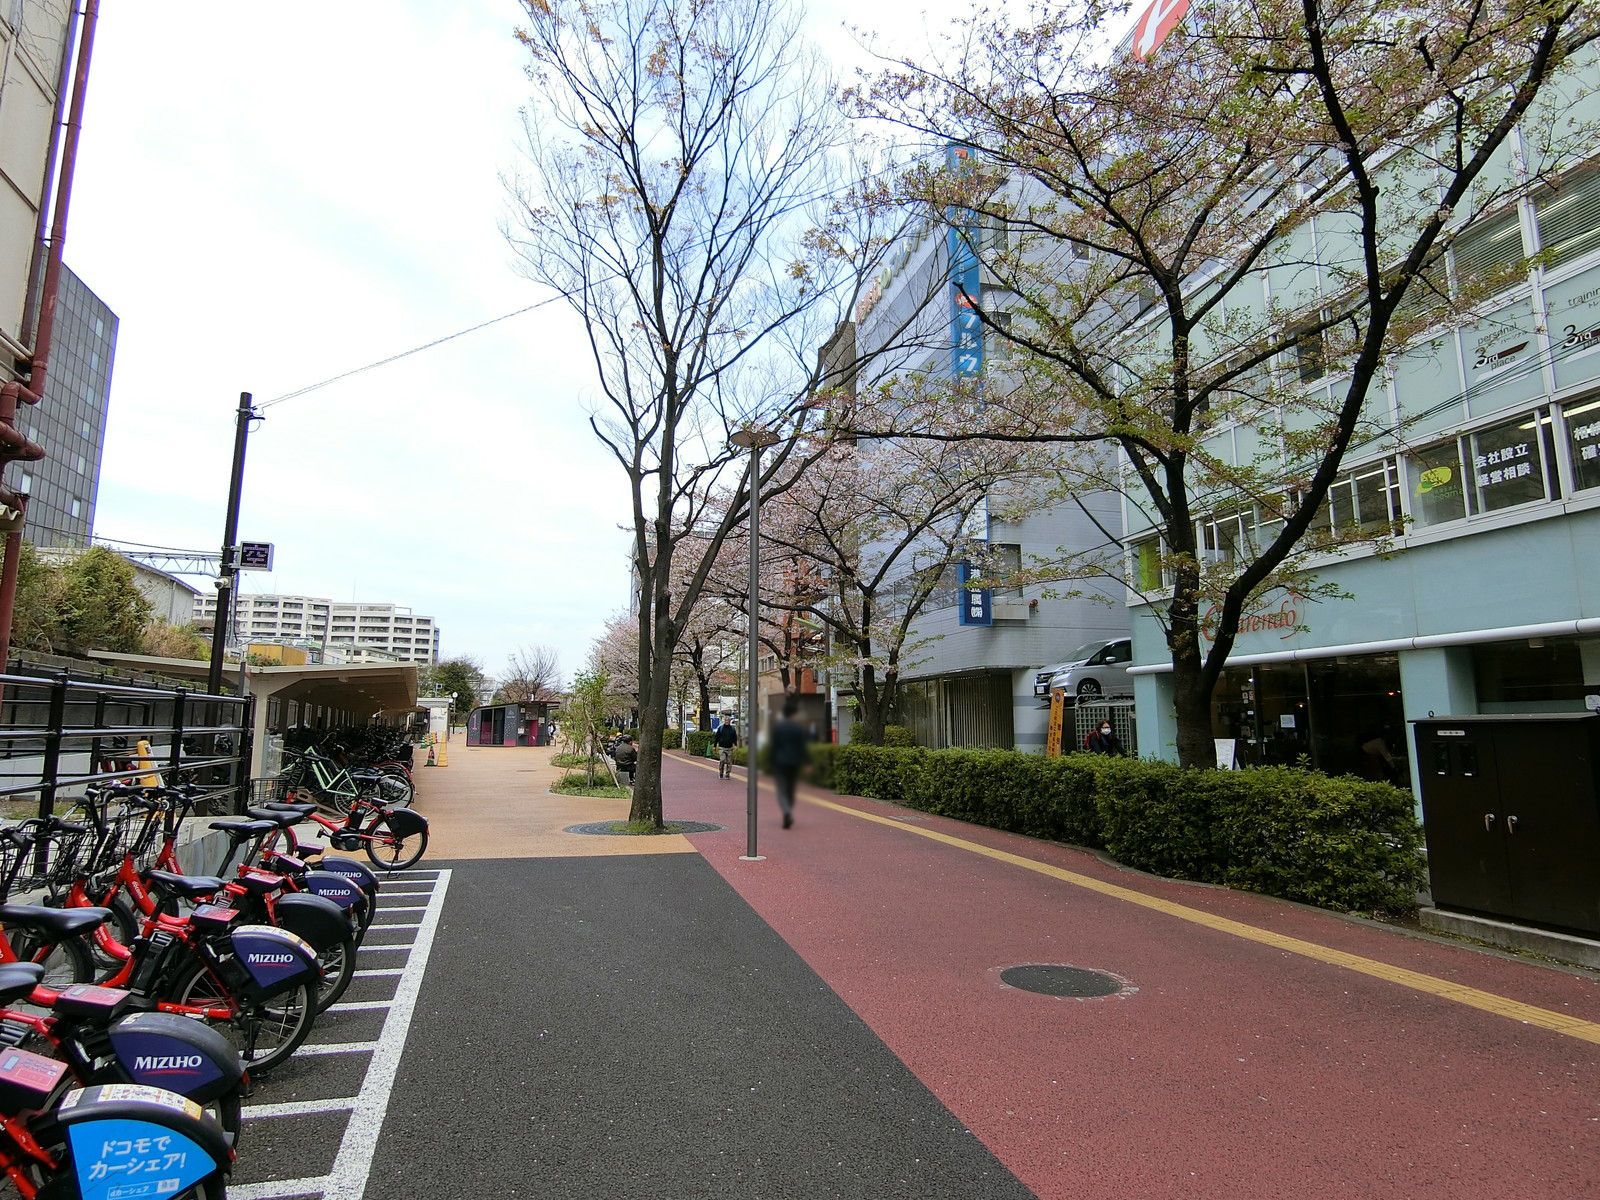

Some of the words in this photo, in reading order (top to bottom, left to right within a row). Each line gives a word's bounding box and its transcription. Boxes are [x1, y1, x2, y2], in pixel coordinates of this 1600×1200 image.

[1477, 321, 1517, 346] personal
[1475, 346, 1498, 368] 3rd
[1491, 354, 1516, 371] place
[1475, 443, 1528, 469] 会社設立
[1581, 443, 1600, 460] 確
[1476, 462, 1531, 488] 経営相談
[1202, 600, 1297, 641] Carendo
[247, 953, 294, 963] MIZUHO
[134, 1055, 203, 1070] MIZUHO
[101, 1135, 172, 1158] ドコモで
[88, 1152, 187, 1179] カーシェア!
[110, 1185, 150, 1197] dカーシェア
